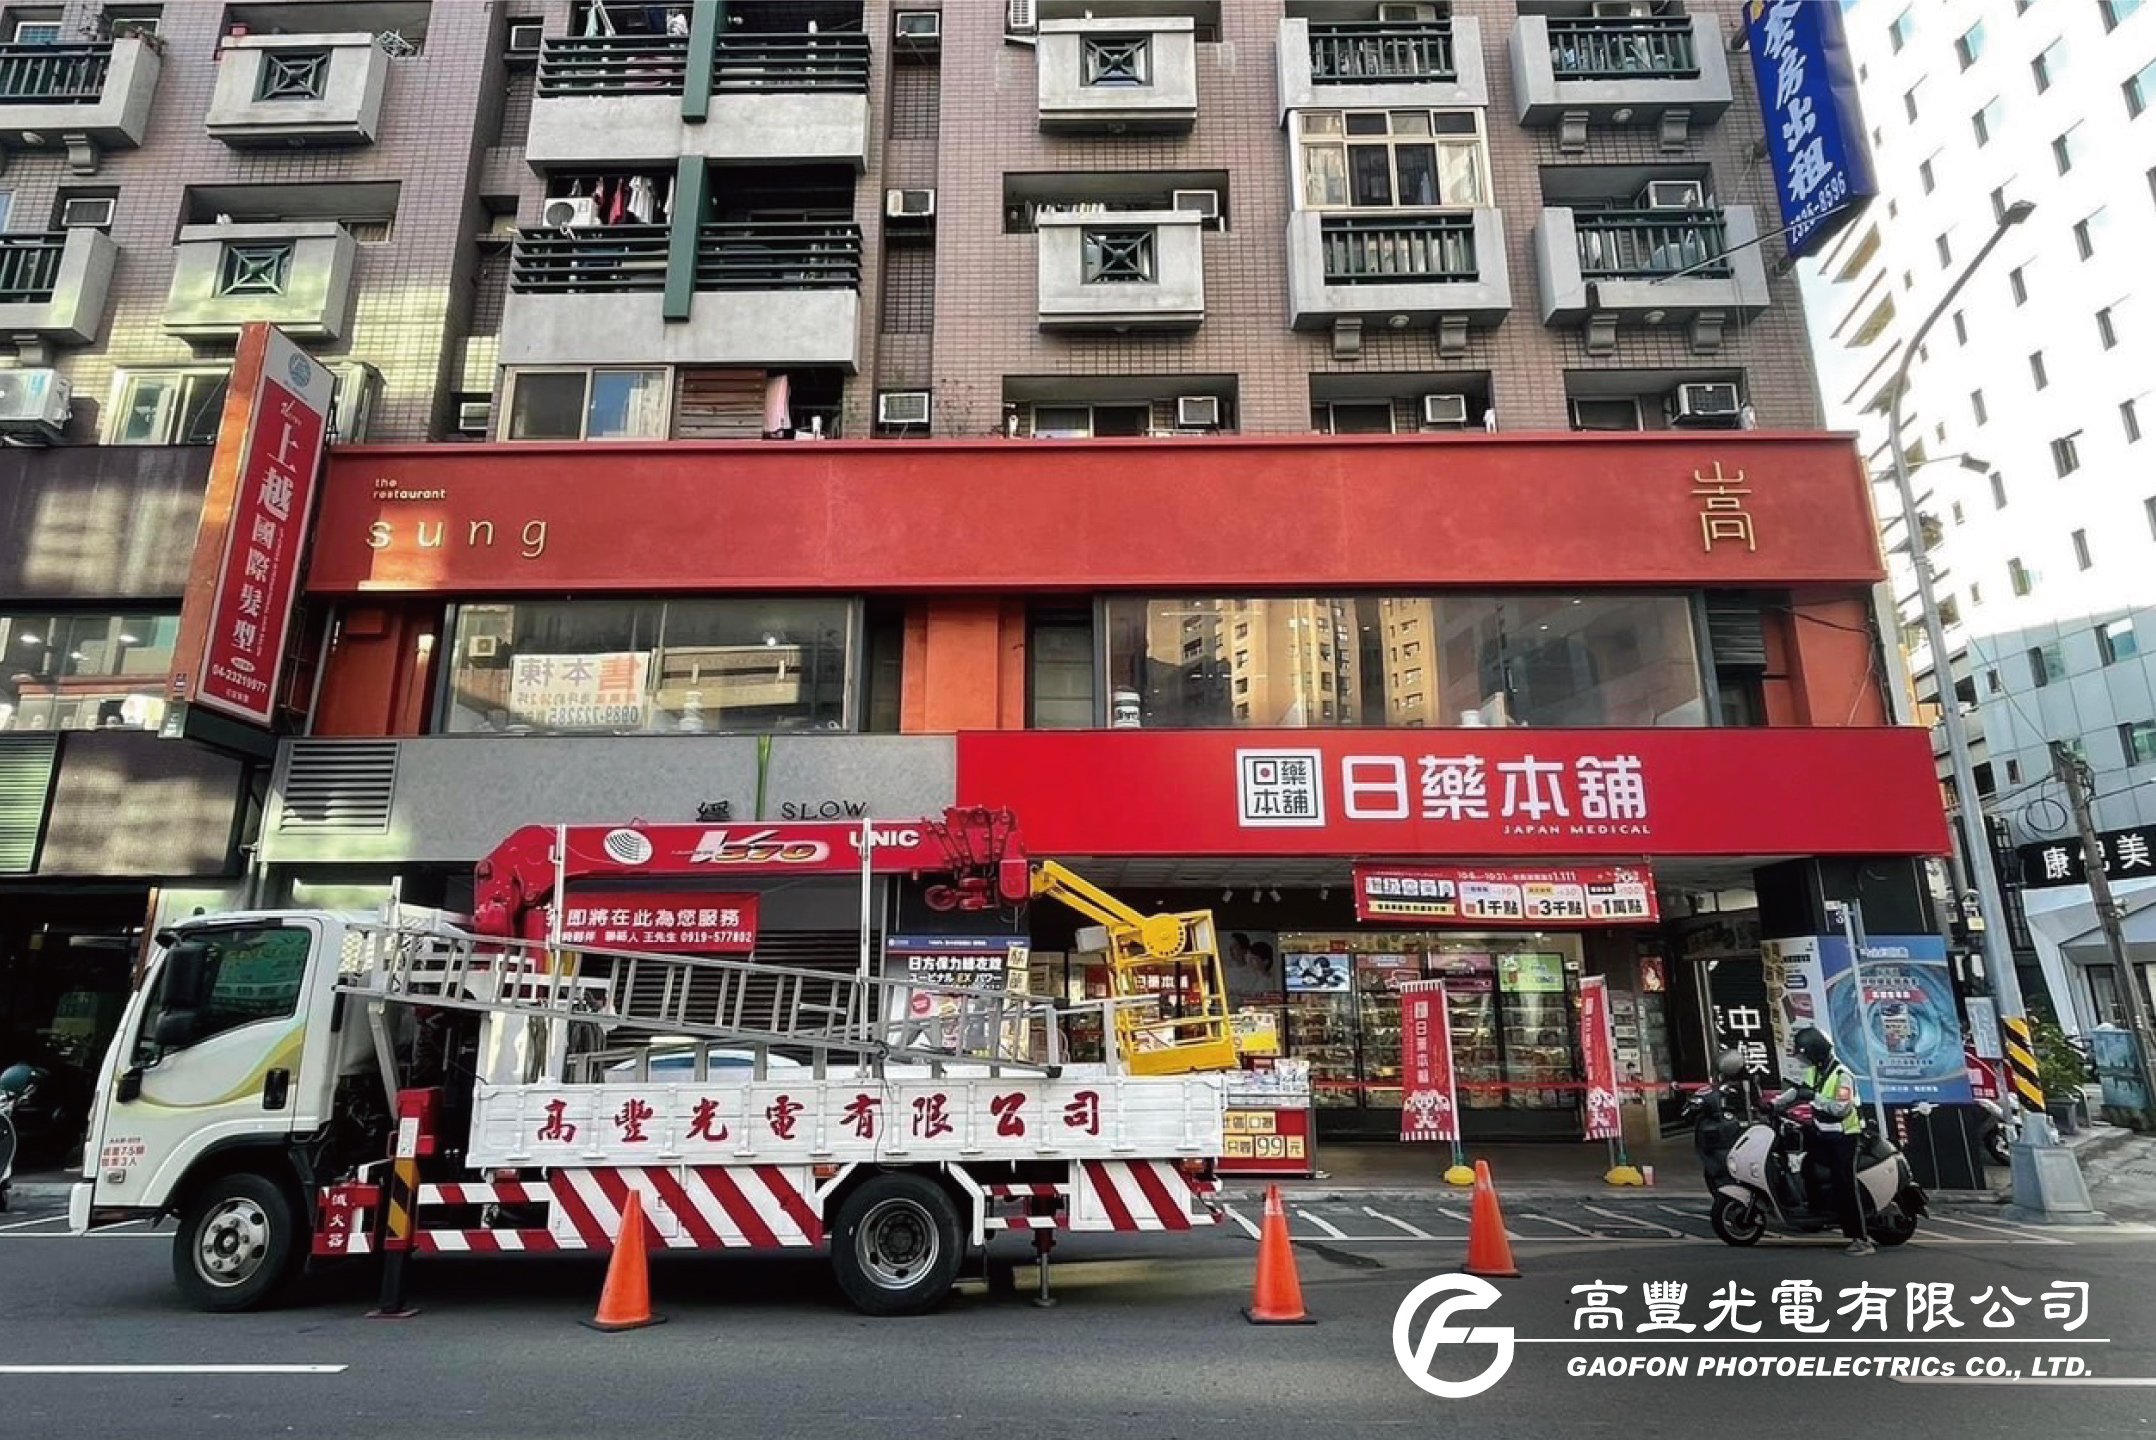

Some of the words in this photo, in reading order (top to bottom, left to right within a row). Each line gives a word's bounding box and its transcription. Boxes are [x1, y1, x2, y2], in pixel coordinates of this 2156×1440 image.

[1764, 0, 1834, 202] 套房出租
[373, 488, 446, 499] restaurant
[375, 478, 397, 488] the
[1690, 460, 1756, 552] 嵩
[231, 421, 299, 652] 上越國際髮型
[366, 519, 548, 558] sung
[1342, 754, 1647, 820] 日藥本舖
[781, 800, 867, 820] SLOW
[1503, 824, 1560, 834] JAPAN
[1570, 824, 1651, 834] MEDICAL
[849, 829, 920, 847] UNIC
[2042, 833, 2152, 879] 康美
[536, 1091, 1101, 1144] 高豐光電有限公司
[1256, 1136, 1282, 1156] 99
